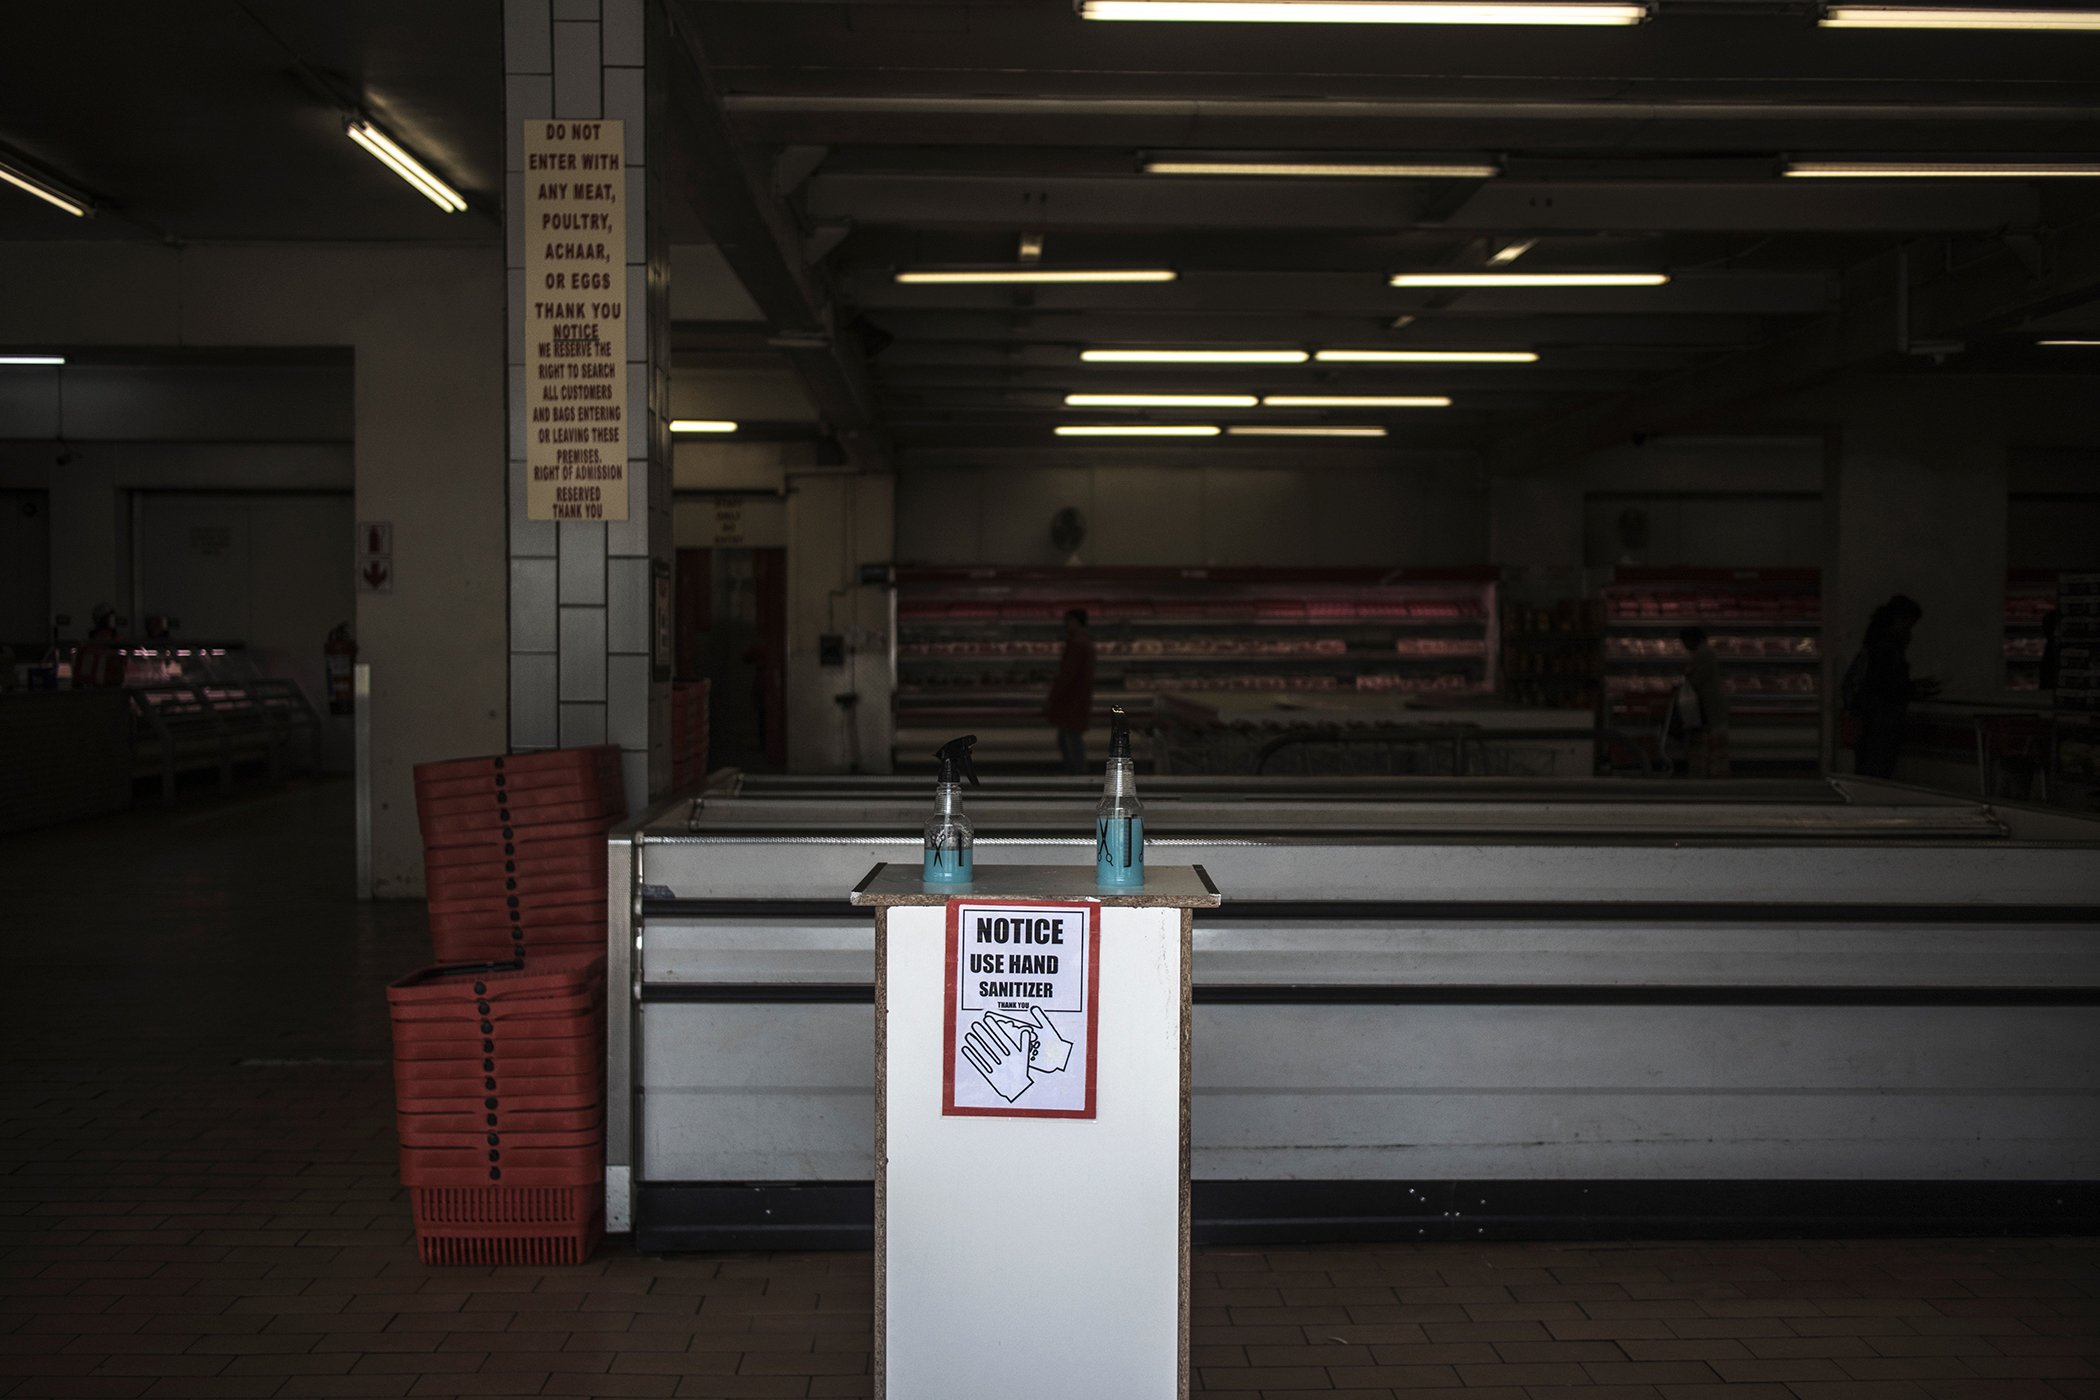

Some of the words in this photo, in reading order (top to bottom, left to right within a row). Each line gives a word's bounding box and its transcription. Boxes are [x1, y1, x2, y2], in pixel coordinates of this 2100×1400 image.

[546, 123, 565, 140] DO
[572, 123, 601, 140] NOT
[529, 153, 577, 170] ENTER
[582, 153, 619, 170] WITH
[539, 183, 567, 200] ANY
[573, 183, 616, 203] MEAT,
[542, 213, 612, 233] POULTRY,
[545, 243, 610, 262] ACHAAR,
[545, 272, 565, 290] OR
[571, 272, 611, 290] EGGS
[535, 302, 586, 319] THANK
[592, 302, 621, 319] YOU
[553, 323, 599, 340] NOTICE
[538, 342, 551, 358] WE
[554, 342, 592, 358] RESERVE
[594, 341, 612, 357] THE
[538, 363, 564, 379] RIGHT
[567, 363, 579, 378] TO
[581, 363, 616, 378] SEARCH
[543, 385, 559, 401] ALL
[561, 384, 613, 400] CUSTOMERS
[533, 406, 551, 422] AND
[553, 405, 576, 422] BAGS
[578, 405, 621, 421] ENTERING
[538, 427, 551, 443] OR
[553, 427, 589, 443] LEAVING
[592, 426, 619, 443] THESE
[534, 465, 560, 481] RIGHT
[562, 465, 574, 480] OF
[576, 464, 623, 480] ADMISSION
[556, 486, 601, 502] RESERVED
[552, 503, 582, 519] THANK
[586, 503, 603, 519] YOU
[976, 917, 1064, 945] NOTICE
[970, 953, 1004, 974] USE
[1009, 955, 1059, 975] HAND
[979, 981, 1053, 998] SANITIZER
[997, 1001, 1017, 1009] THANK
